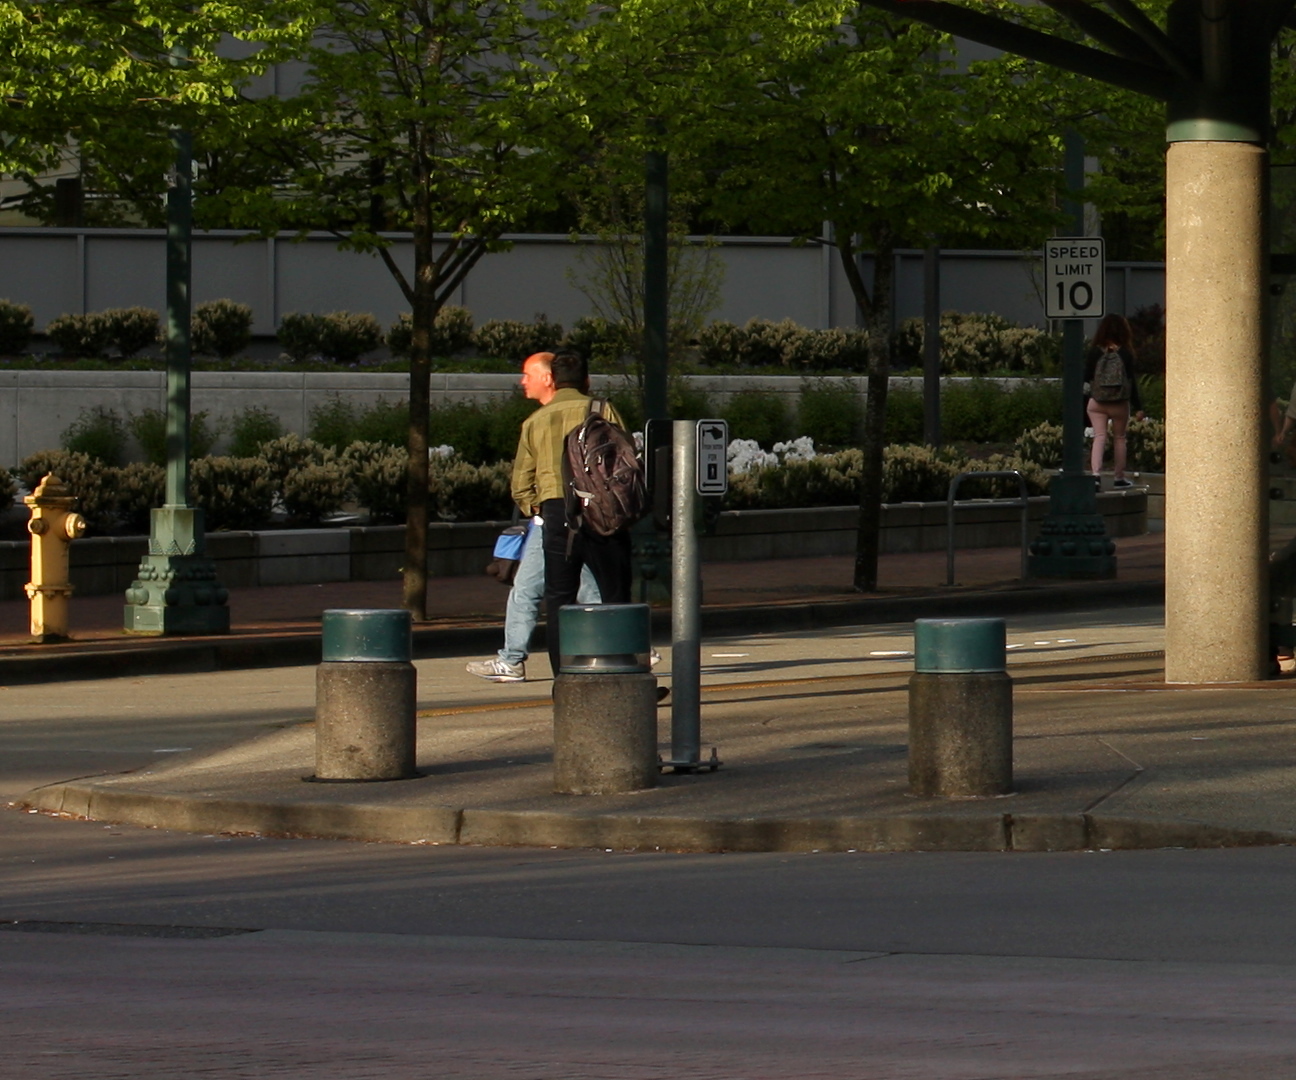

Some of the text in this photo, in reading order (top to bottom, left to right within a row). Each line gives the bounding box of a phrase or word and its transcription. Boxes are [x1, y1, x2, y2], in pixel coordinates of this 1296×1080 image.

[1049, 246, 1099, 259] SPEED
[1055, 263, 1093, 276] LIMIT
[1056, 280, 1093, 311] 10
